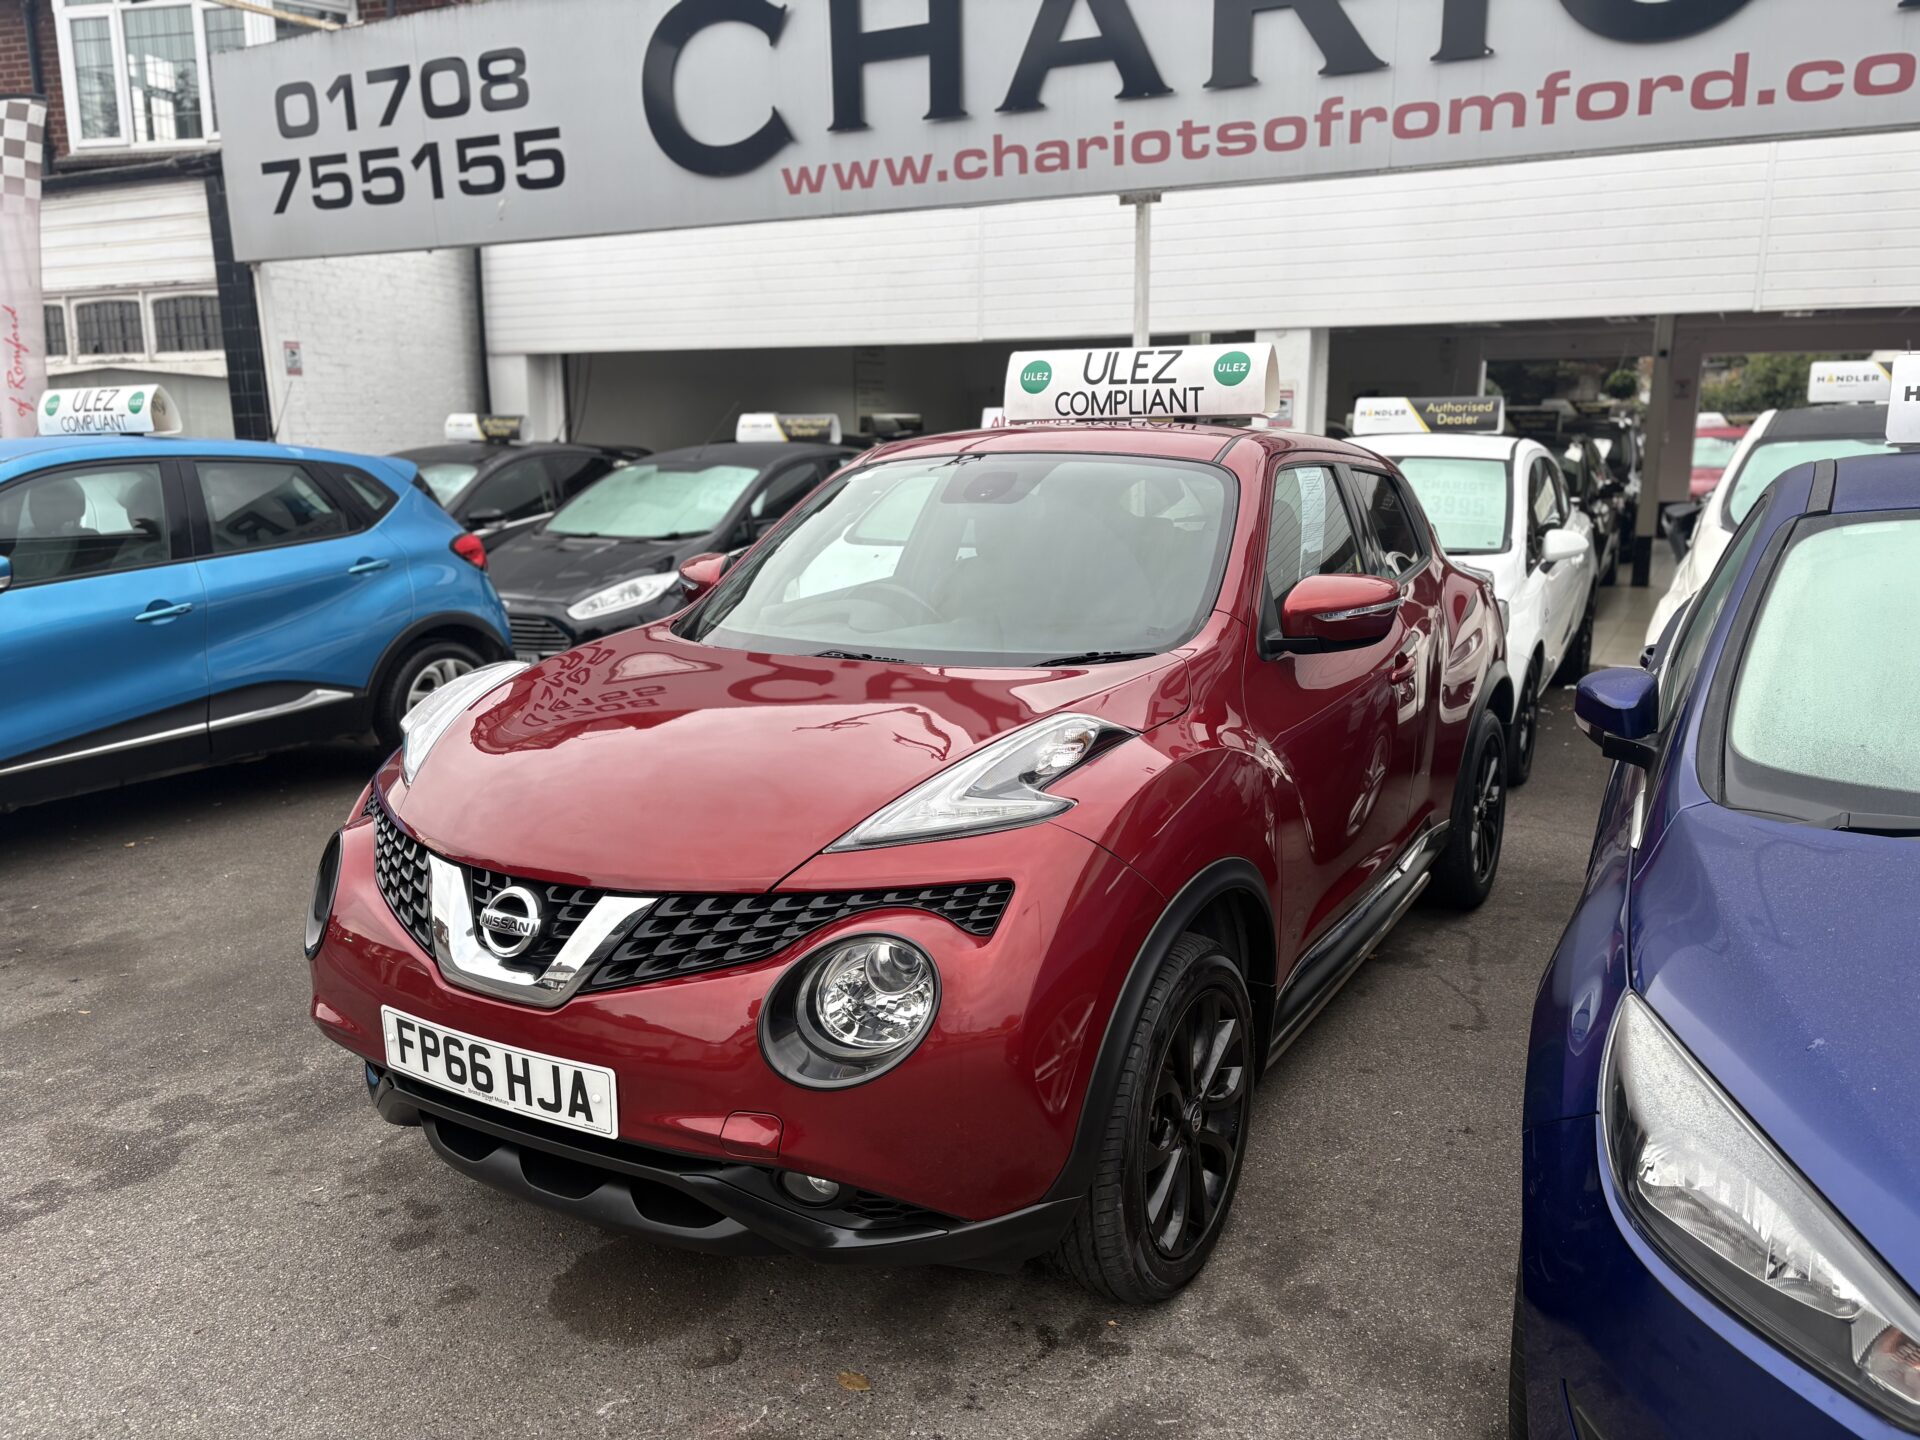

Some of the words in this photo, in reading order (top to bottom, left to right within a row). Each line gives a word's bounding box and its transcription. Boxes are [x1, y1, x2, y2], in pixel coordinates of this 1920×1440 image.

[274, 46, 530, 140] 01708
[781, 51, 1918, 196] www.chariotsofromford.co
[260, 126, 566, 215] 755155
[1023, 371, 1048, 382] ULEZ
[1083, 350, 1183, 385] ULEZ
[1217, 362, 1248, 373] ULEZ
[72, 388, 120, 413] ULEZ
[1054, 386, 1204, 417] COMPLIANT
[1425, 402, 1494, 413] Authorised
[60, 414, 128, 433] COMPLIANT
[1437, 413, 1480, 426] Dealer
[481, 912, 531, 933] NISSAN
[396, 1017, 494, 1095] FP66
[504, 1053, 594, 1123] HJA
